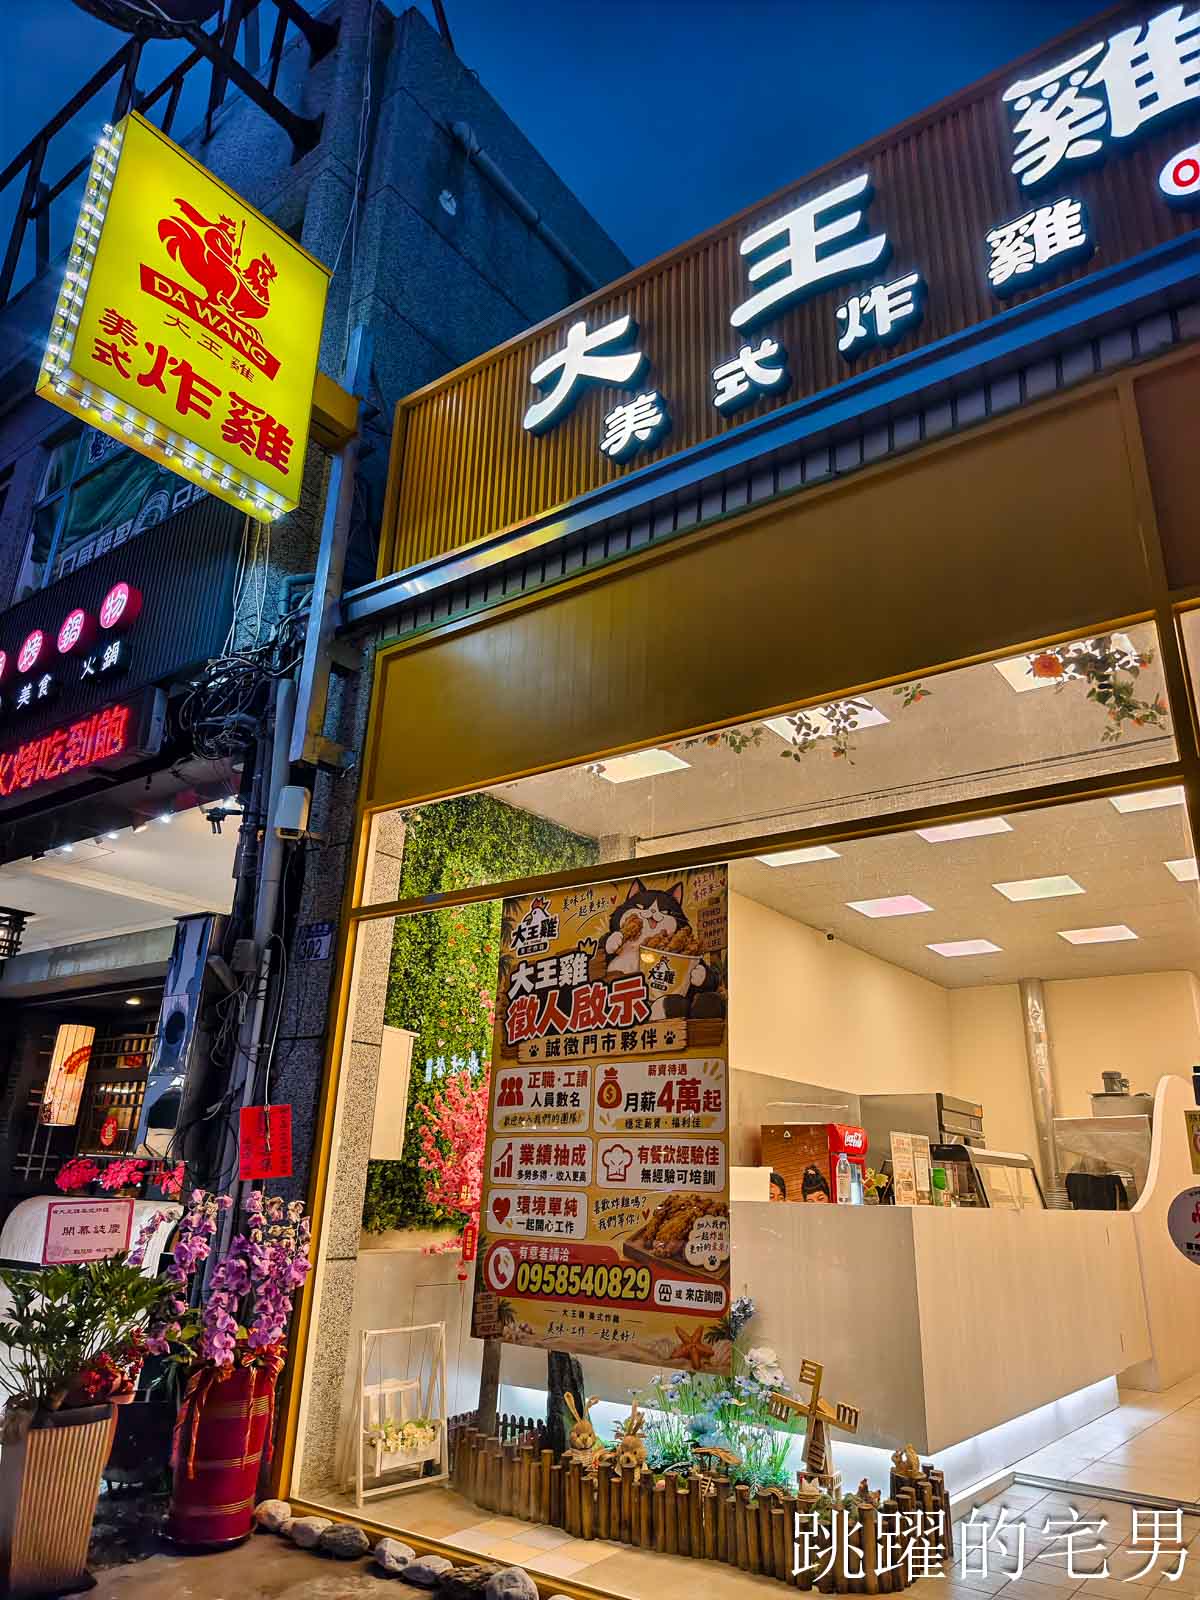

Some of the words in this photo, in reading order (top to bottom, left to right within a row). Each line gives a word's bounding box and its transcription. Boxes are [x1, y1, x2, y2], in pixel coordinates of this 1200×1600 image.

[523, 3, 1200, 433] 大王雞
[600, 197, 1087, 457] 美式炸雞
[163, 313, 255, 383] 大王雞
[511, 917, 558, 949] 大王雞
[508, 953, 589, 998] 大王雞
[506, 976, 649, 1044] 徵人啟示
[545, 1029, 657, 1057] 誠徵門市夥伴
[530, 1091, 581, 1108] 人員數名
[624, 1078, 722, 1113] 月薪4萬起
[519, 1144, 587, 1167] 業績抽成
[637, 1145, 720, 1166] 有餐飲經驗佳
[640, 1168, 716, 1185] 無經驗可培訓
[516, 1195, 578, 1217] 環境單純
[61, 1224, 121, 1237] 開幕誌慶
[516, 1218, 576, 1233] 一起開心工作
[516, 1262, 651, 1299] 0958540829
